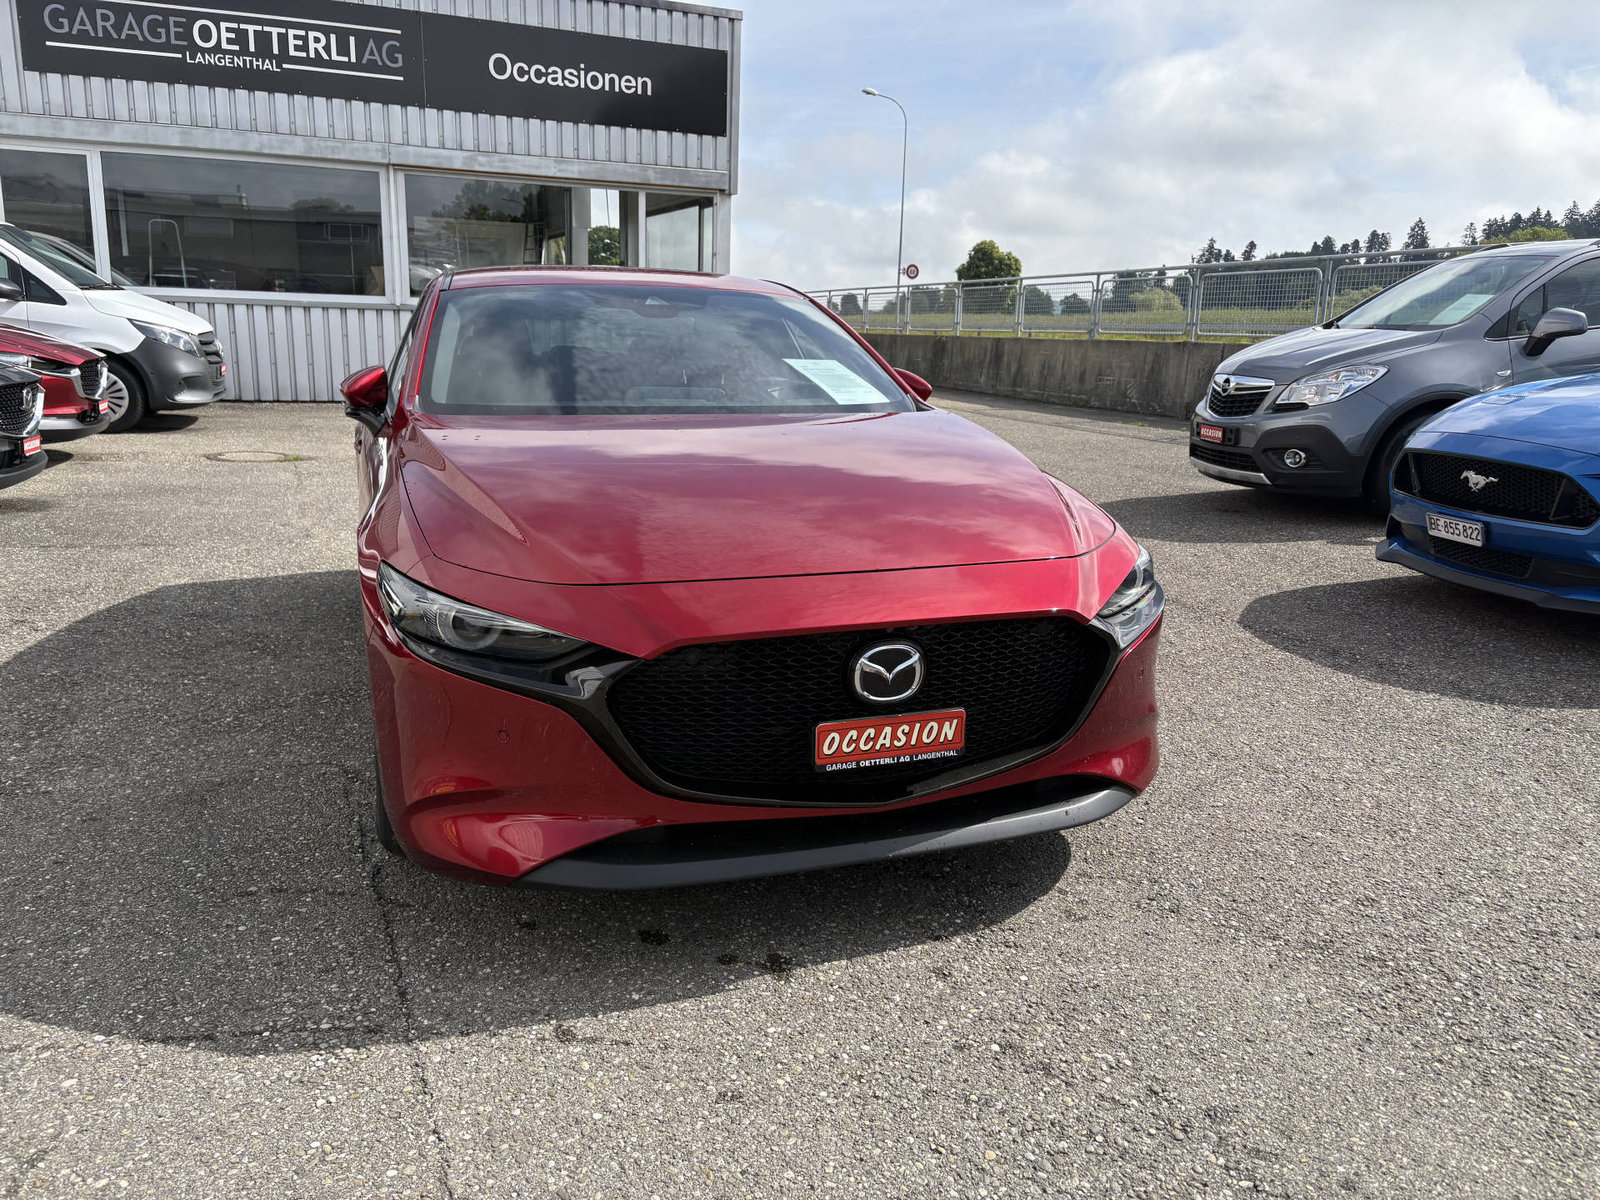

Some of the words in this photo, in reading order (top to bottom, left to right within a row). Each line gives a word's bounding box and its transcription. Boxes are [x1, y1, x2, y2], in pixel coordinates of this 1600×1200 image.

[43, 4, 188, 46] GARAGE
[192, 19, 357, 63] OETTERLI
[361, 38, 403, 68] AG
[186, 51, 281, 72] LANGENTHAL
[488, 53, 652, 96] Occasionen
[1201, 426, 1222, 438] OCCASION
[822, 718, 958, 756] OCCASION
[826, 761, 857, 772] GARAGE
[859, 757, 898, 768] OETTERLI
[899, 755, 911, 763] AG
[913, 749, 958, 761] LANGENTHAL
